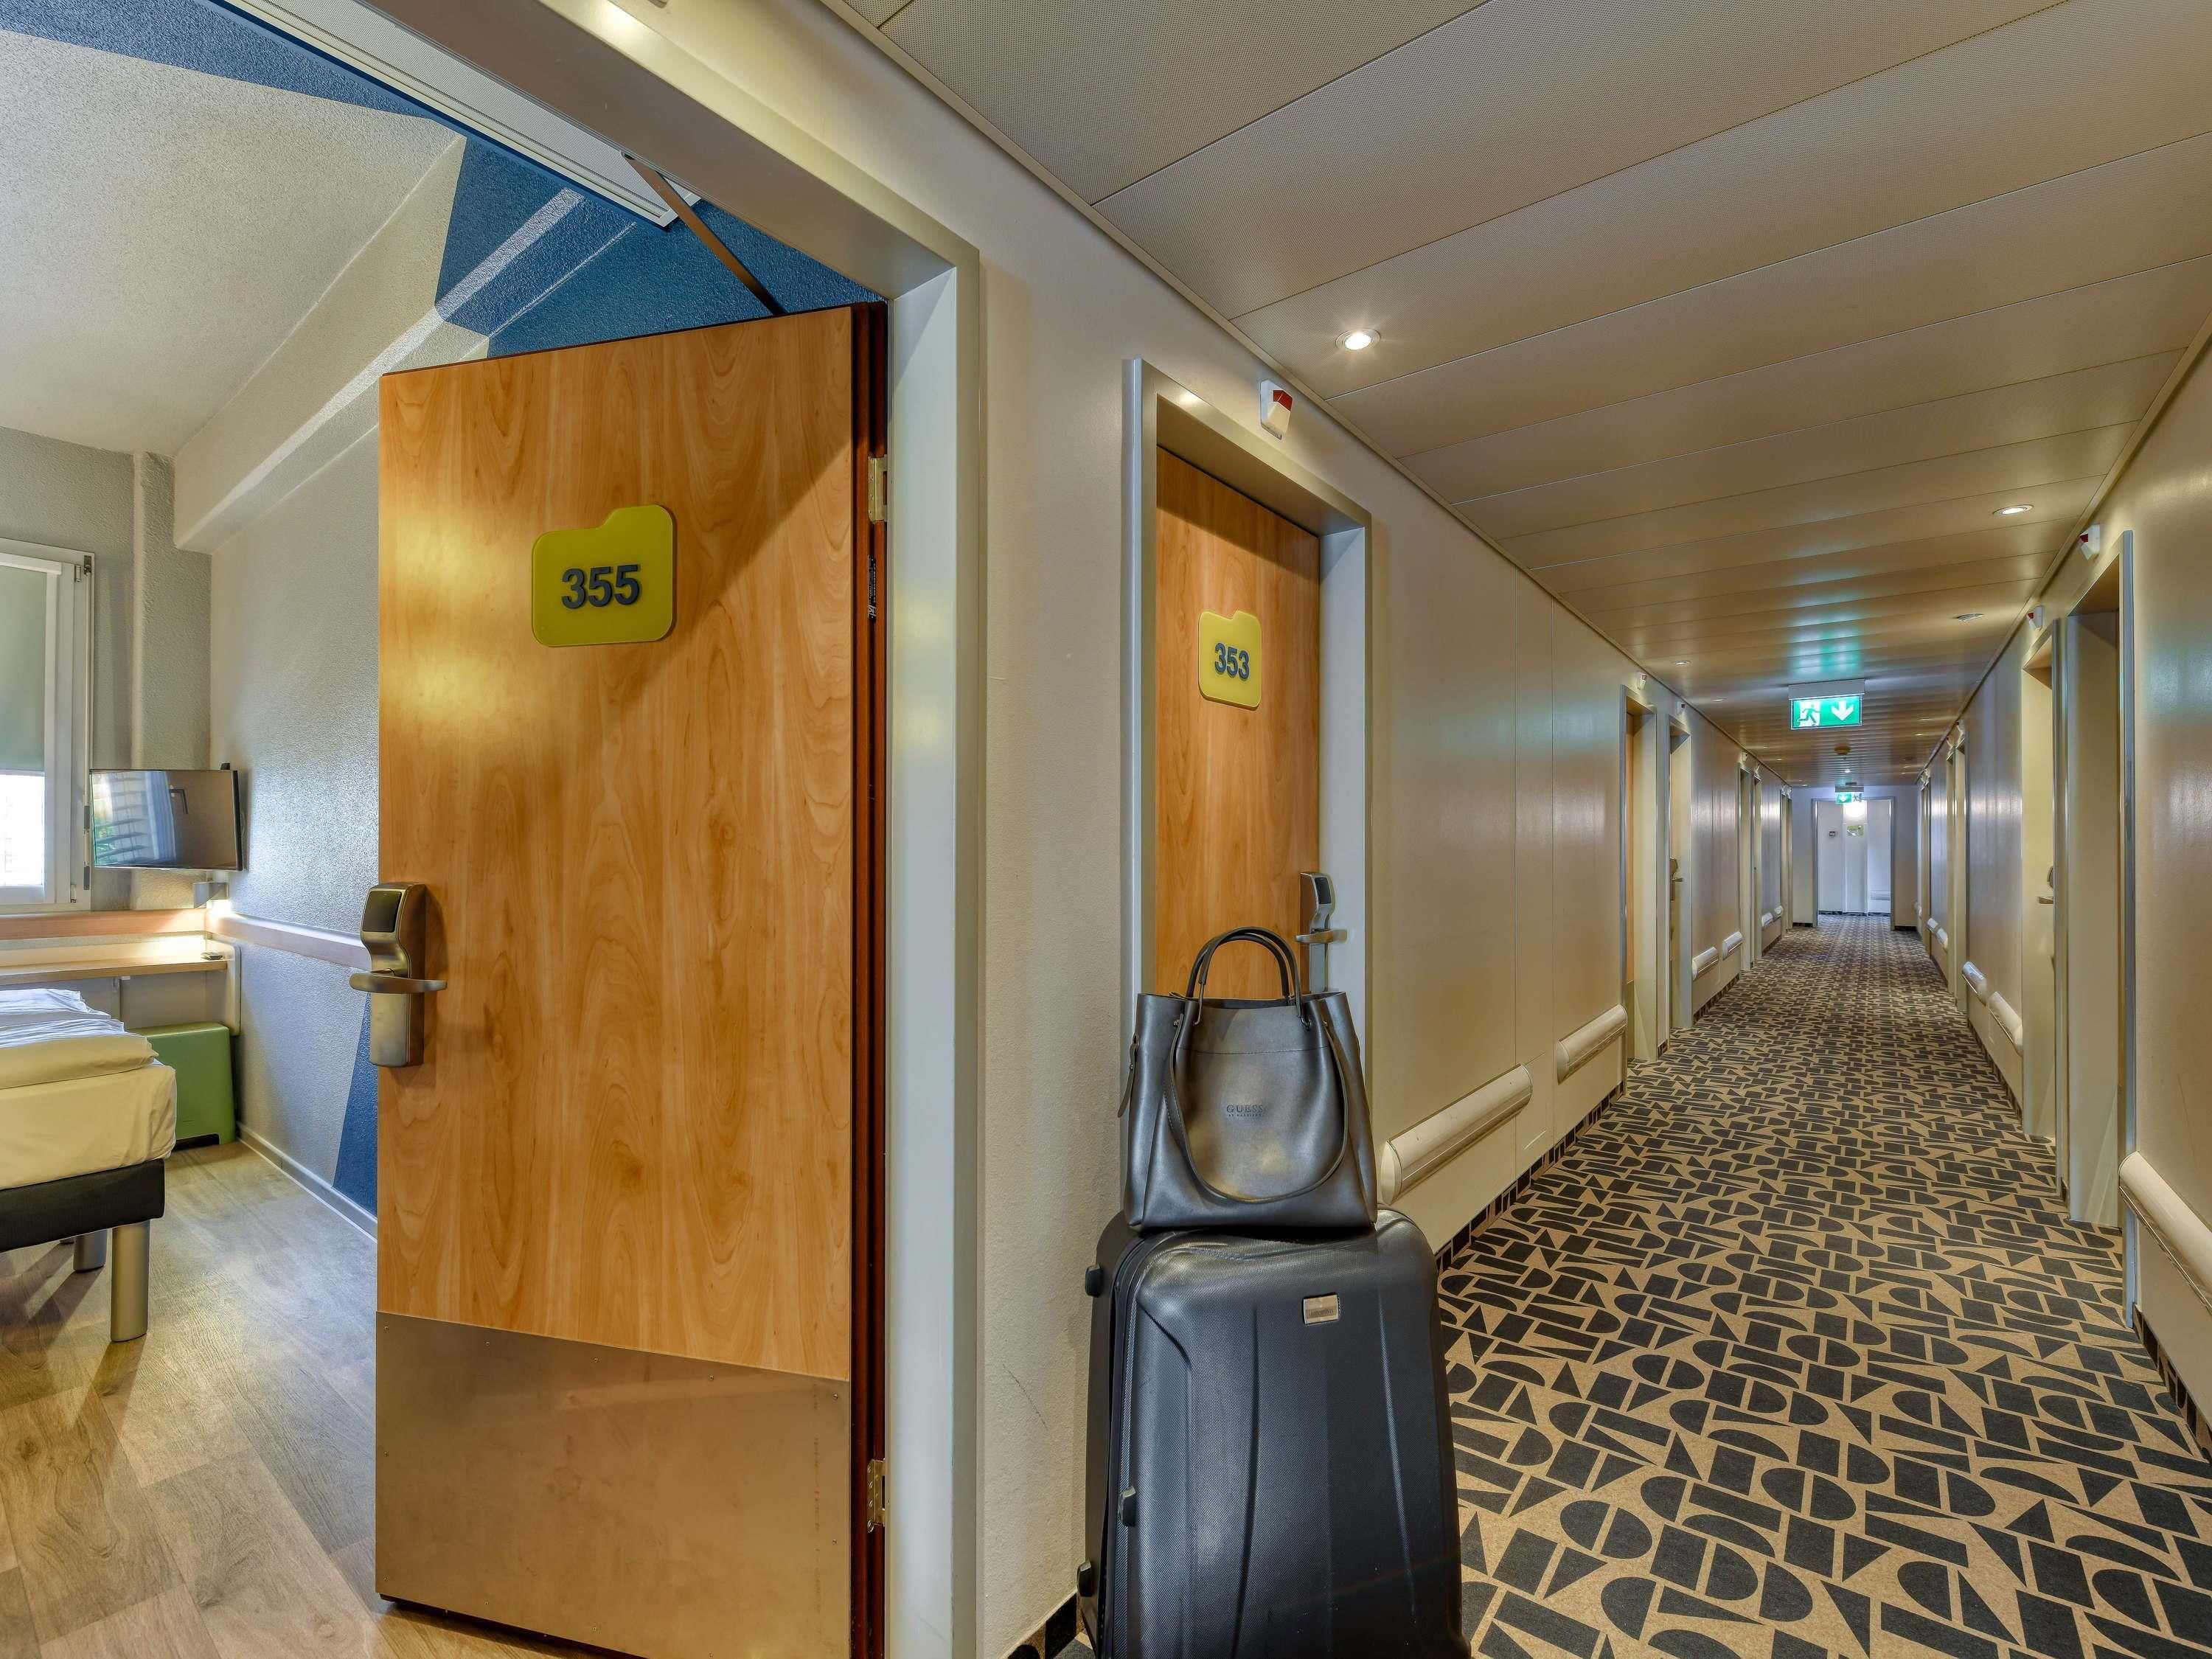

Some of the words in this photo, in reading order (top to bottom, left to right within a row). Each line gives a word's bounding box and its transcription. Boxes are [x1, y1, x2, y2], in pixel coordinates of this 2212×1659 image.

[561, 564, 640, 609] 355
[1214, 642, 1250, 681] 353
[1226, 1105, 1263, 1113] GUESS
